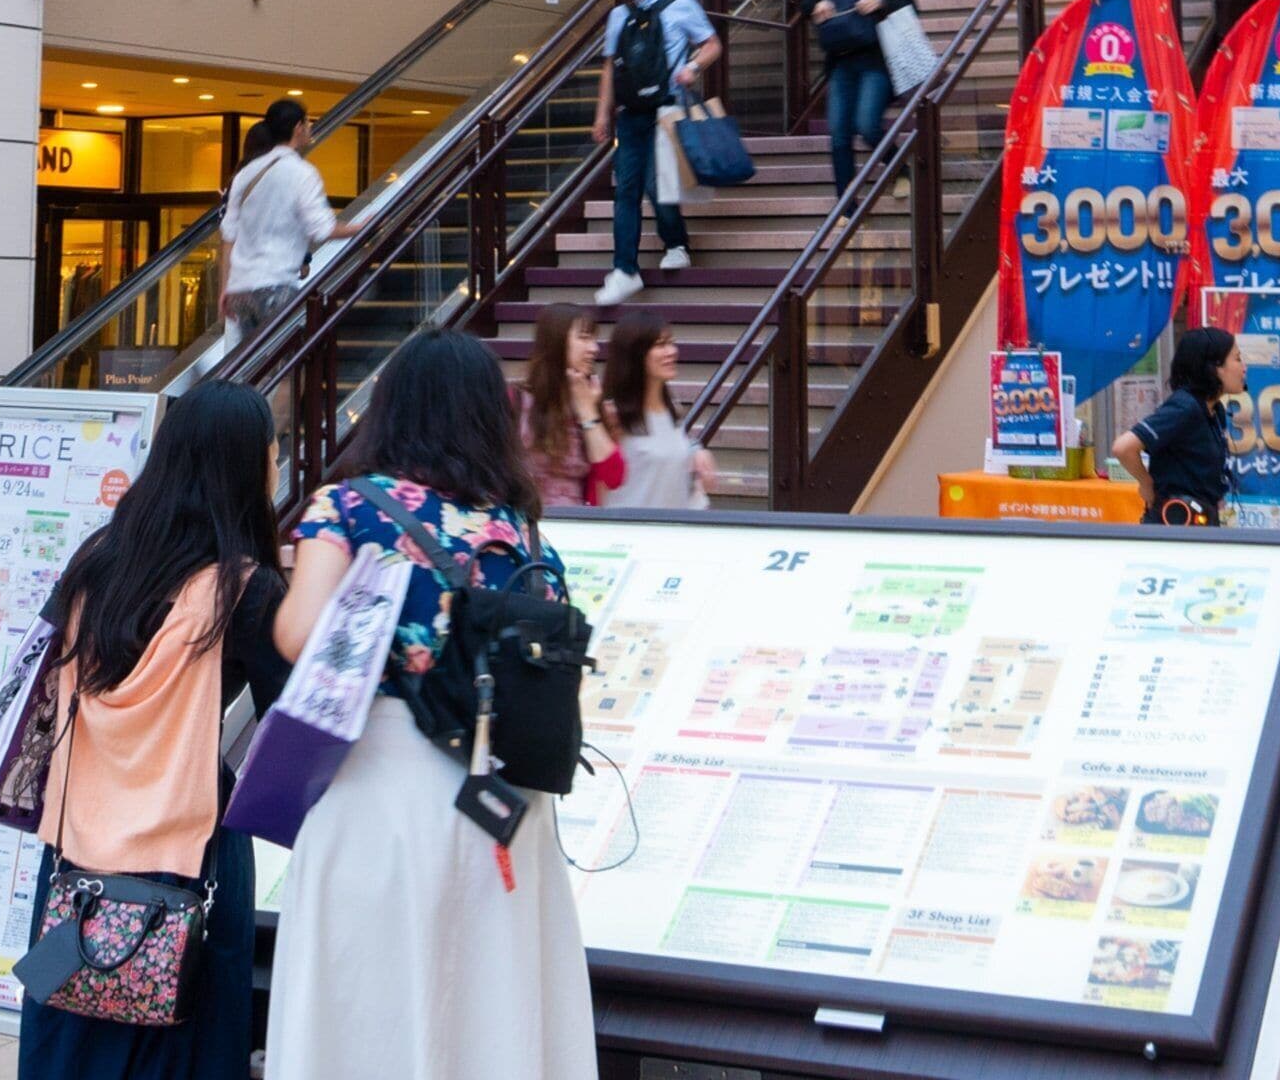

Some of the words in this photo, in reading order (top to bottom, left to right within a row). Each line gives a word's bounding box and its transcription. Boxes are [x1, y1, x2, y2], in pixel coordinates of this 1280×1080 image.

[1059, 84, 1159, 104] 新規ご入会で
[1020, 166, 1058, 186] 最大
[1210, 167, 1249, 188] 最大
[1020, 184, 1188, 257] 3,000
[105, 374, 127, 385] Plus
[2, 479, 32, 498] 9/24
[763, 550, 810, 571] 2F
[1136, 577, 1178, 596] 3F
[653, 753, 668, 765] 2F
[670, 754, 701, 769] Shop
[703, 757, 726, 768] List
[1081, 761, 1112, 775] Cafe
[1115, 764, 1128, 775] &
[1131, 764, 1208, 780] Restaurant
[927, 911, 964, 925] Shop
[967, 915, 992, 926] List
